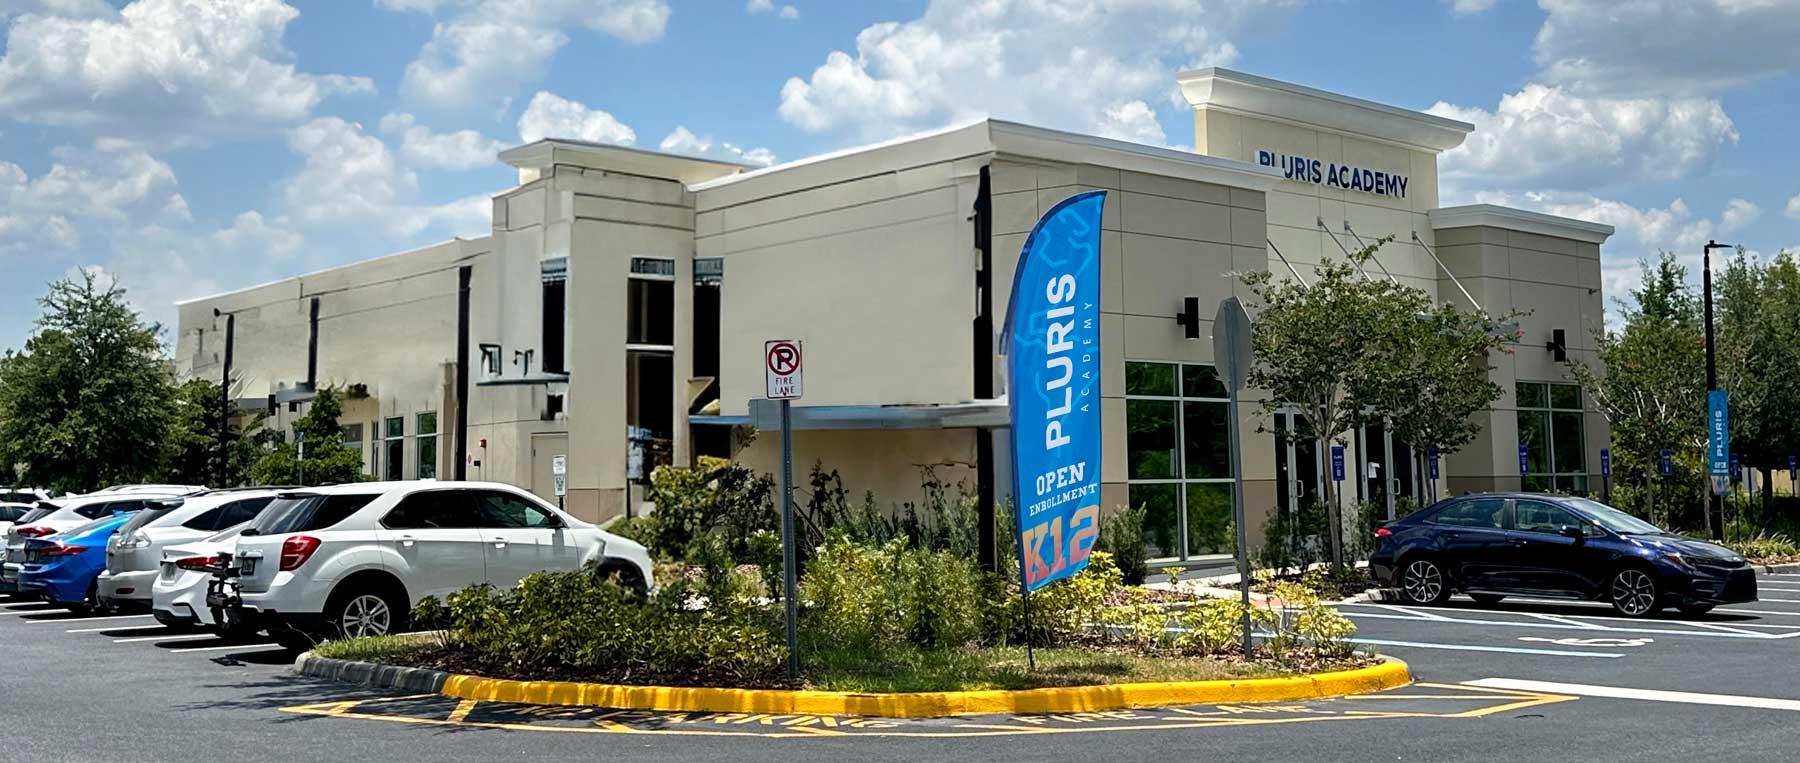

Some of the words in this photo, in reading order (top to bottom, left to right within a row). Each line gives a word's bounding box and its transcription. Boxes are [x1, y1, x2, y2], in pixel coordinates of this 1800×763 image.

[1326, 163, 1408, 198] ACADEMY
[1046, 273, 1076, 450] PLURIS
[1080, 302, 1093, 412] ACADEMY
[774, 386, 795, 395] LANE
[775, 377, 794, 385] FIRE
[1715, 410, 1724, 457] PLURIS
[1036, 461, 1086, 496] OPEN
[1029, 482, 1097, 516] ENROLLMENT
[1022, 504, 1100, 584] K12
[1010, 710, 1157, 725] FIRE
